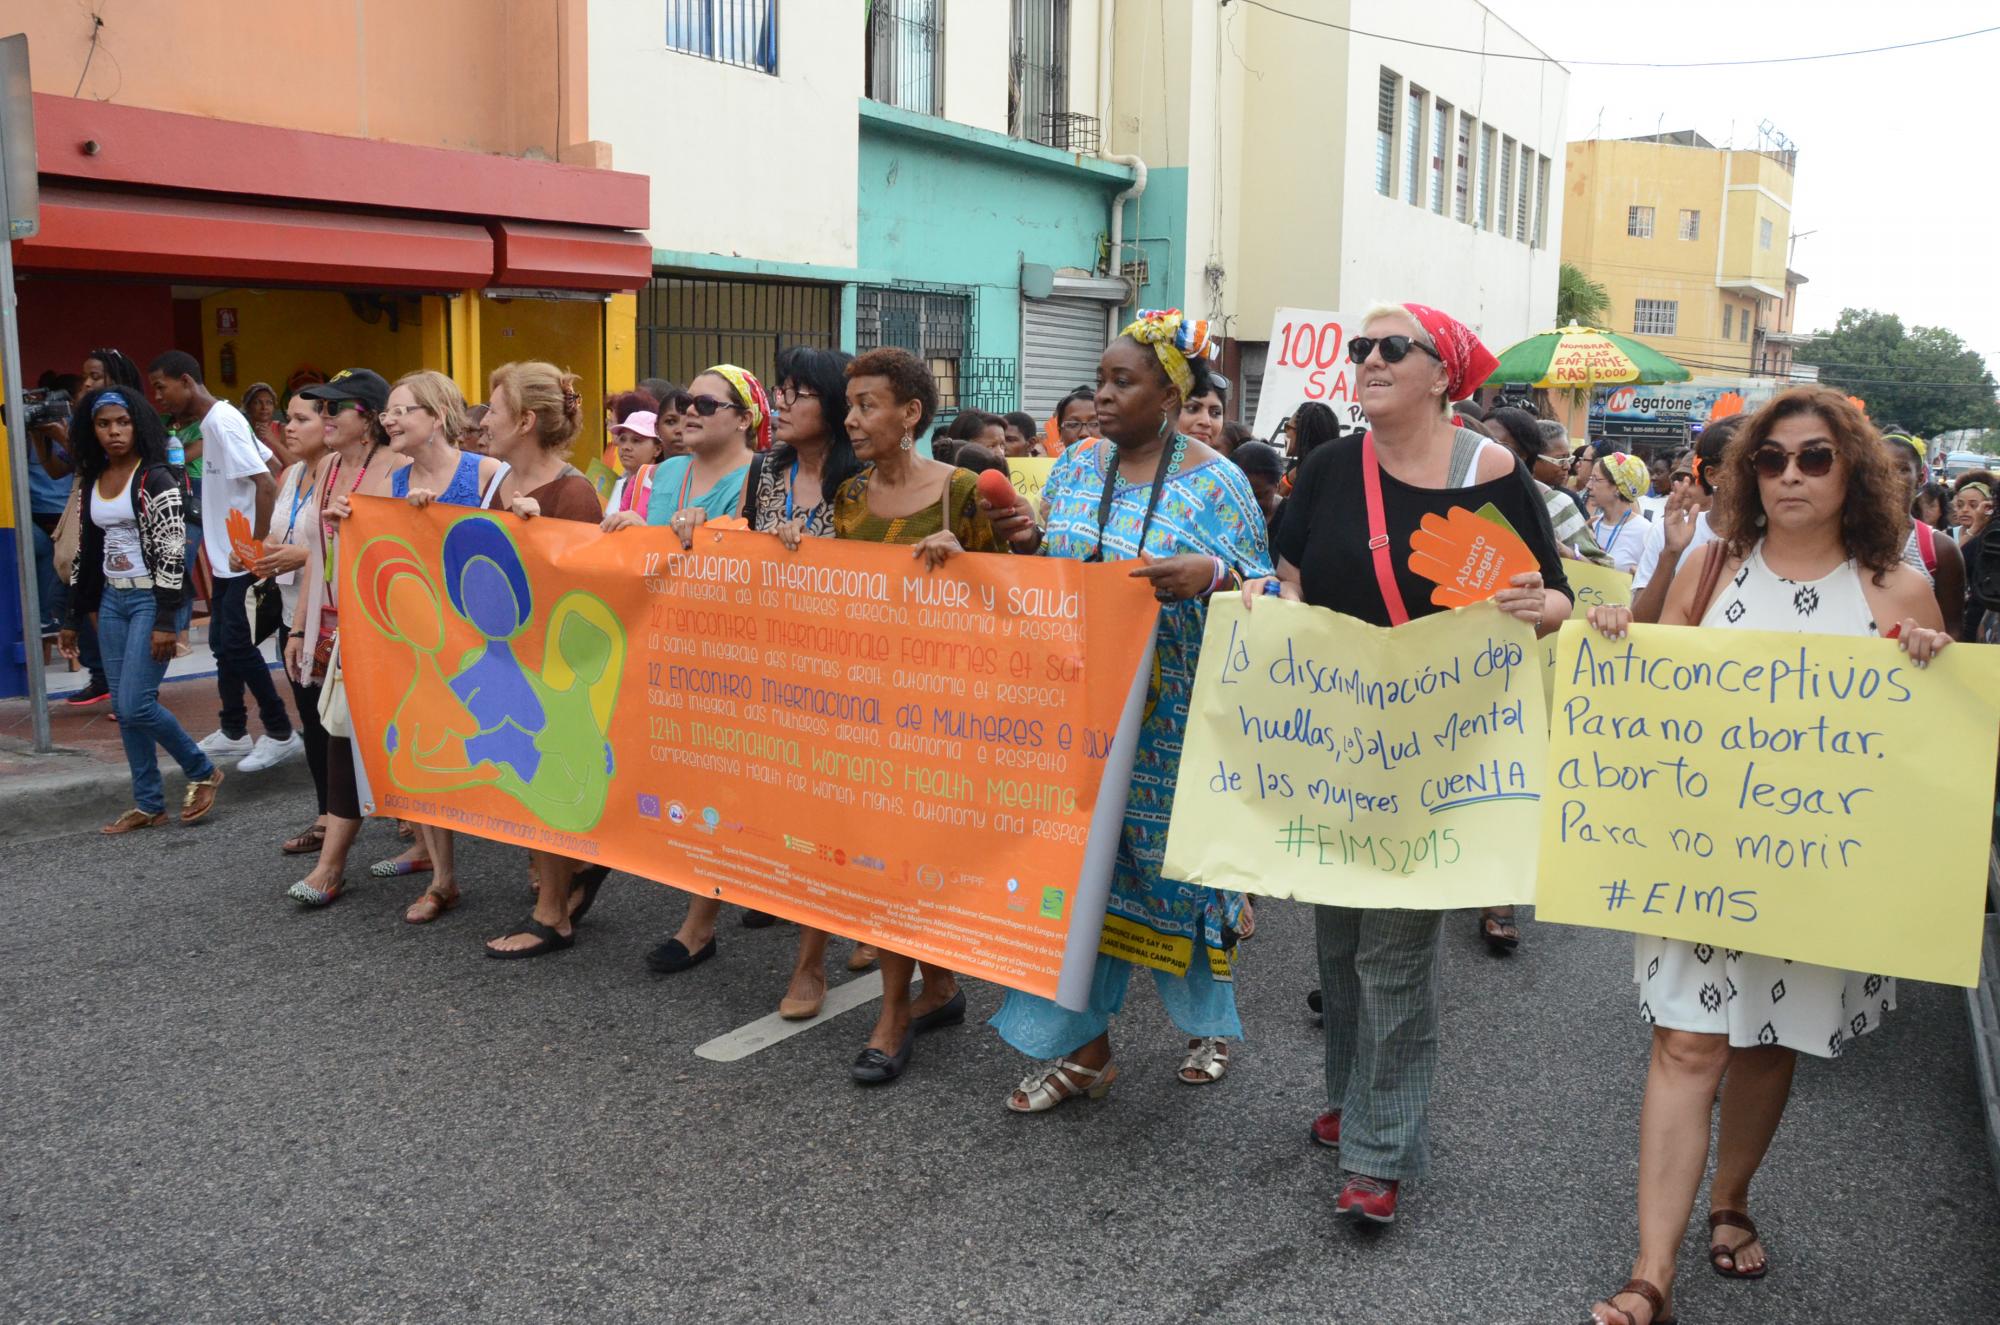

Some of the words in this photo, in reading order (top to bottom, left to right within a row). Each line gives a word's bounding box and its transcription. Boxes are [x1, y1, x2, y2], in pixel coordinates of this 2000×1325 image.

[1560, 342, 1614, 350] NOMBRAR
[1587, 350, 1609, 358] LAS
[1557, 367, 1587, 381] RAS
[1612, 391, 1692, 413] Megatone
[1456, 535, 1486, 587] Aborto
[1469, 544, 1496, 589] Legal
[641, 552, 660, 577] 12
[761, 560, 890, 601] Internacional
[903, 575, 970, 609] Mujer
[981, 584, 995, 611] y
[1007, 586, 1079, 619] Salud
[735, 587, 752, 606] de
[759, 589, 779, 609] las
[1009, 650, 1033, 680] et
[1221, 619, 1251, 684] La
[1269, 637, 1461, 711] discriminación
[1474, 637, 1523, 692] deja
[1571, 636, 1912, 704] Anticonceptivos
[669, 664, 752, 700] Encontro
[761, 676, 885, 726] Internacional
[896, 703, 923, 731] de
[933, 706, 1044, 748] Mulheres
[1058, 722, 1073, 751] e
[974, 679, 989, 699] et
[1563, 695, 1652, 740] Para
[1660, 717, 1704, 745] no
[691, 720, 804, 769] International
[904, 764, 974, 802] Health
[986, 777, 1077, 816] Meeting
[977, 746, 987, 764] e
[1558, 750, 1708, 798] aborto
[1209, 760, 1242, 794] de
[1257, 763, 1294, 800] las
[993, 813, 1025, 835] and
[1032, 819, 1089, 847] respec
[1274, 814, 1462, 874] #EIMS2015
[1560, 799, 1648, 849] Para
[1669, 826, 1714, 858] no
[1735, 832, 1863, 870] morir
[1147, 938, 1160, 948] SAY
[1162, 943, 1174, 952] NO
